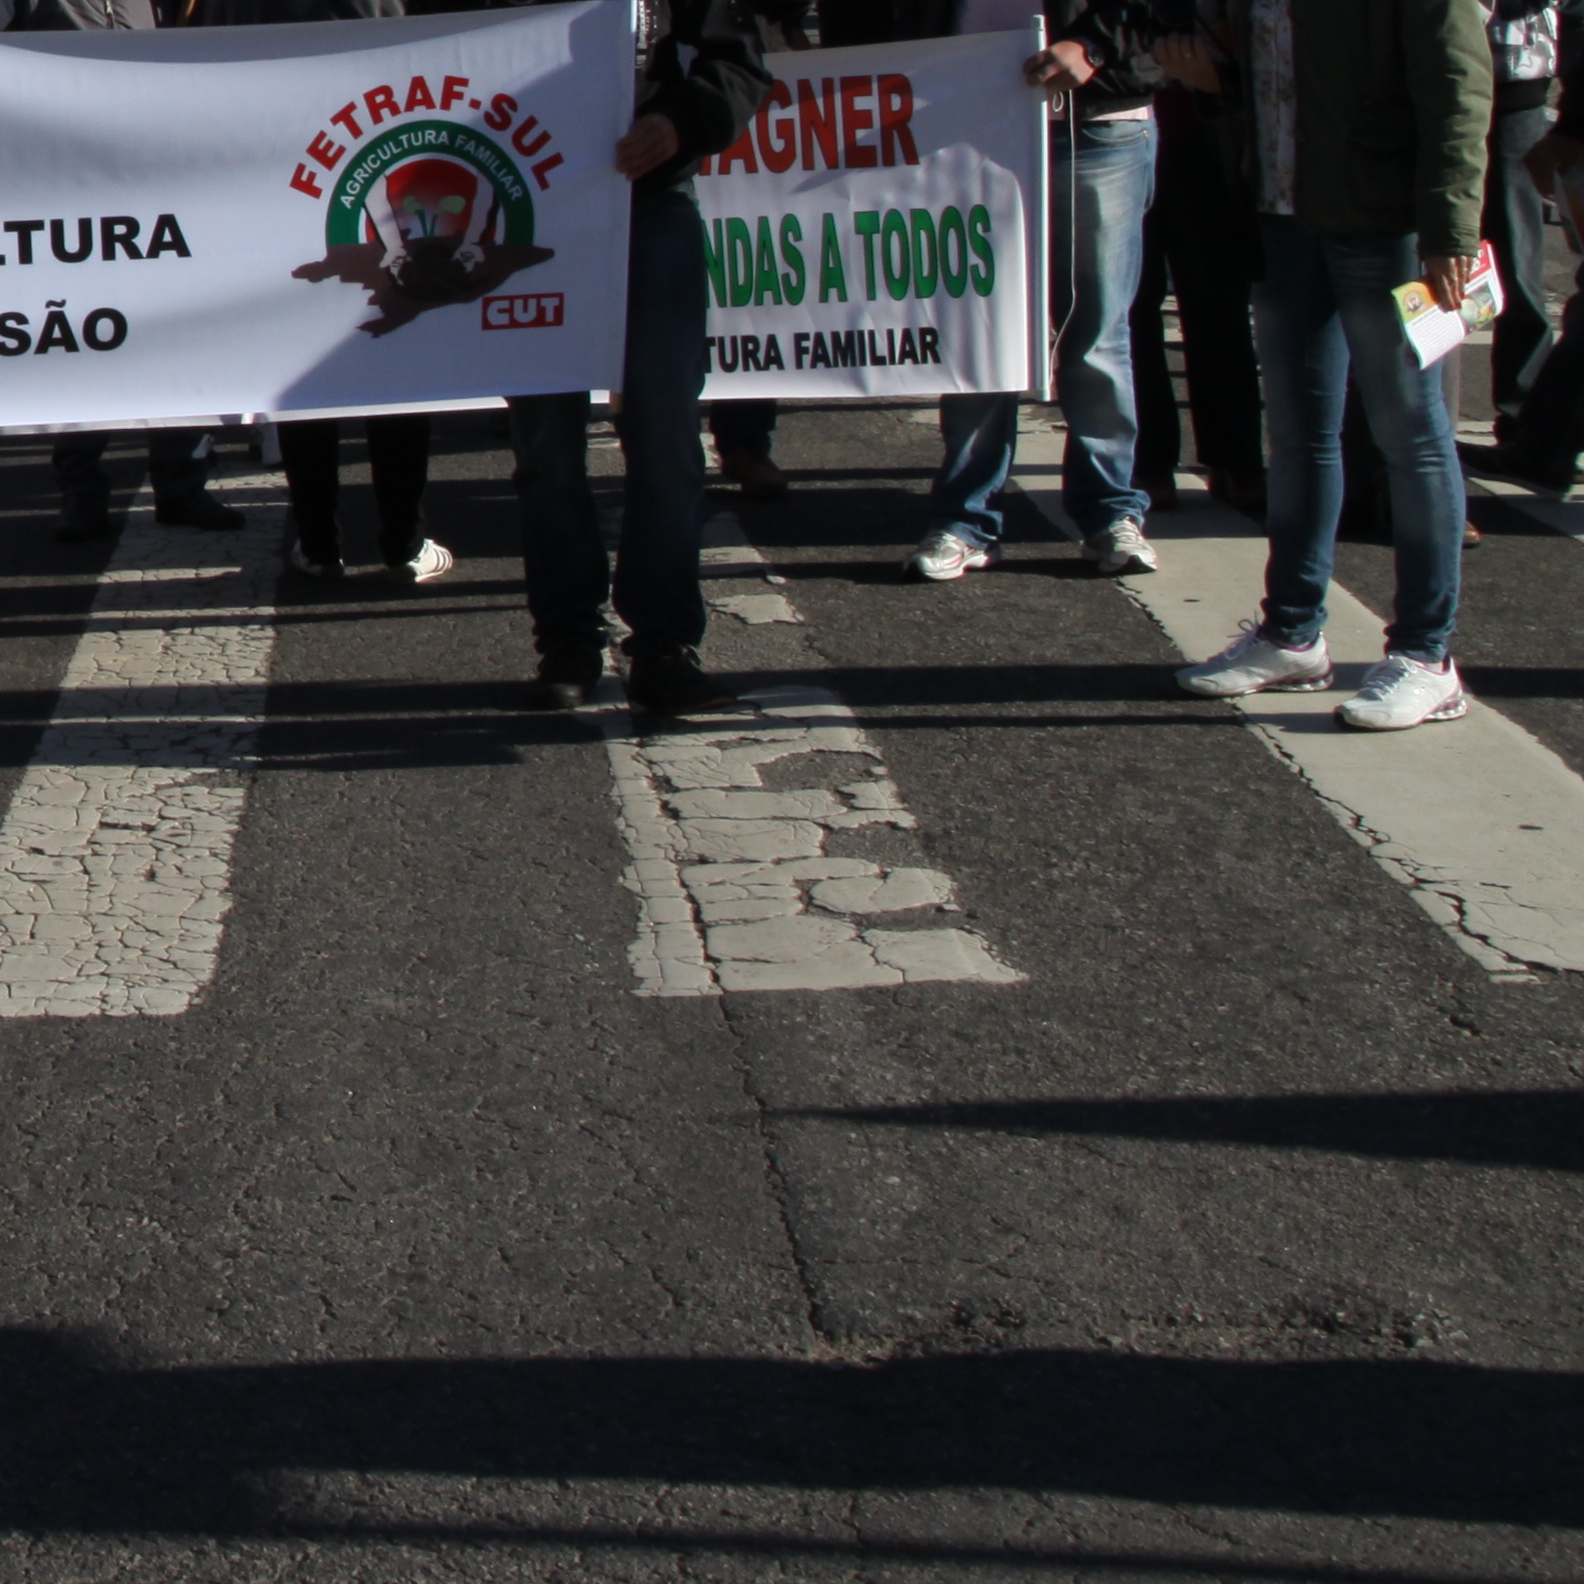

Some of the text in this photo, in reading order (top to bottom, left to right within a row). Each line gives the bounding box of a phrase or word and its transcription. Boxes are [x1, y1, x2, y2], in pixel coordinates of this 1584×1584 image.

[288, 74, 565, 201] FETRAF-SUL
[339, 129, 524, 210] AGRICULTURA FAMILIAR
[698, 72, 920, 177] AGNER
[818, 212, 848, 304] A
[853, 204, 995, 302] TODOS
[485, 296, 561, 327] CUT
[792, 326, 942, 368] FAMILIAR
